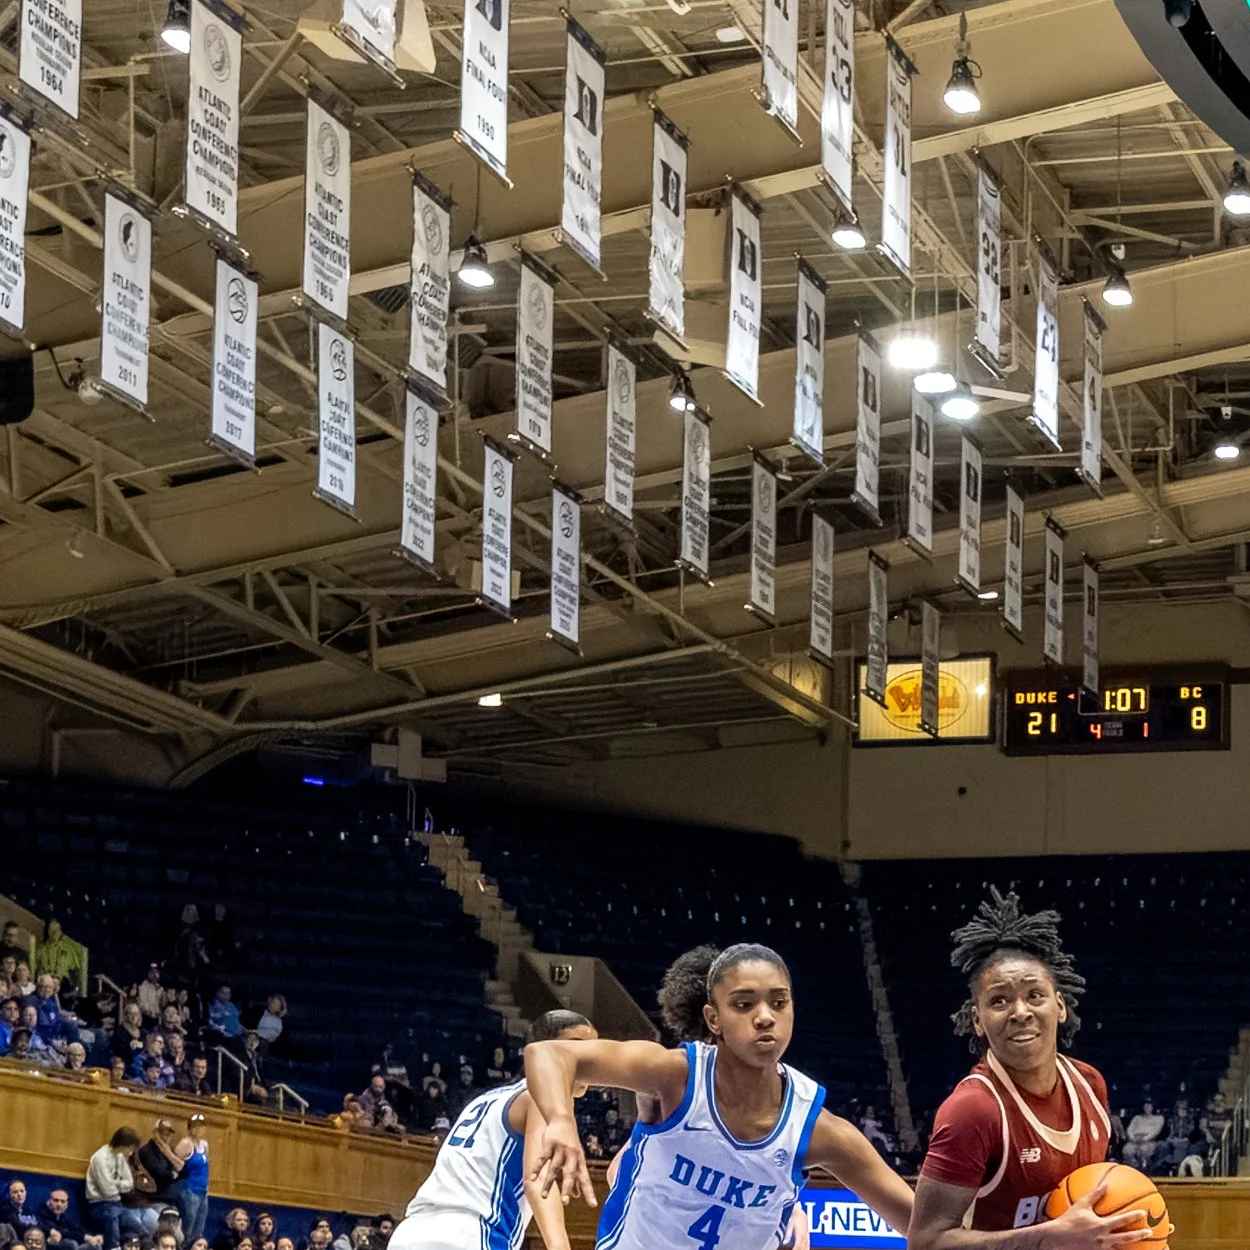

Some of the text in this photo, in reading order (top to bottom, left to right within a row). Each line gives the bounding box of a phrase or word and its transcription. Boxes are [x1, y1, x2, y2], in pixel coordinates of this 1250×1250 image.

[40, 66, 63, 95] 1964
[1015, 691, 1058, 705] DUKE
[1104, 688, 1146, 712] 1:07
[1180, 686, 1203, 699] BC
[1027, 711, 1058, 735] 21
[1190, 706, 1207, 730] 8
[447, 1099, 498, 1148] 21
[669, 1154, 777, 1209] DUKE
